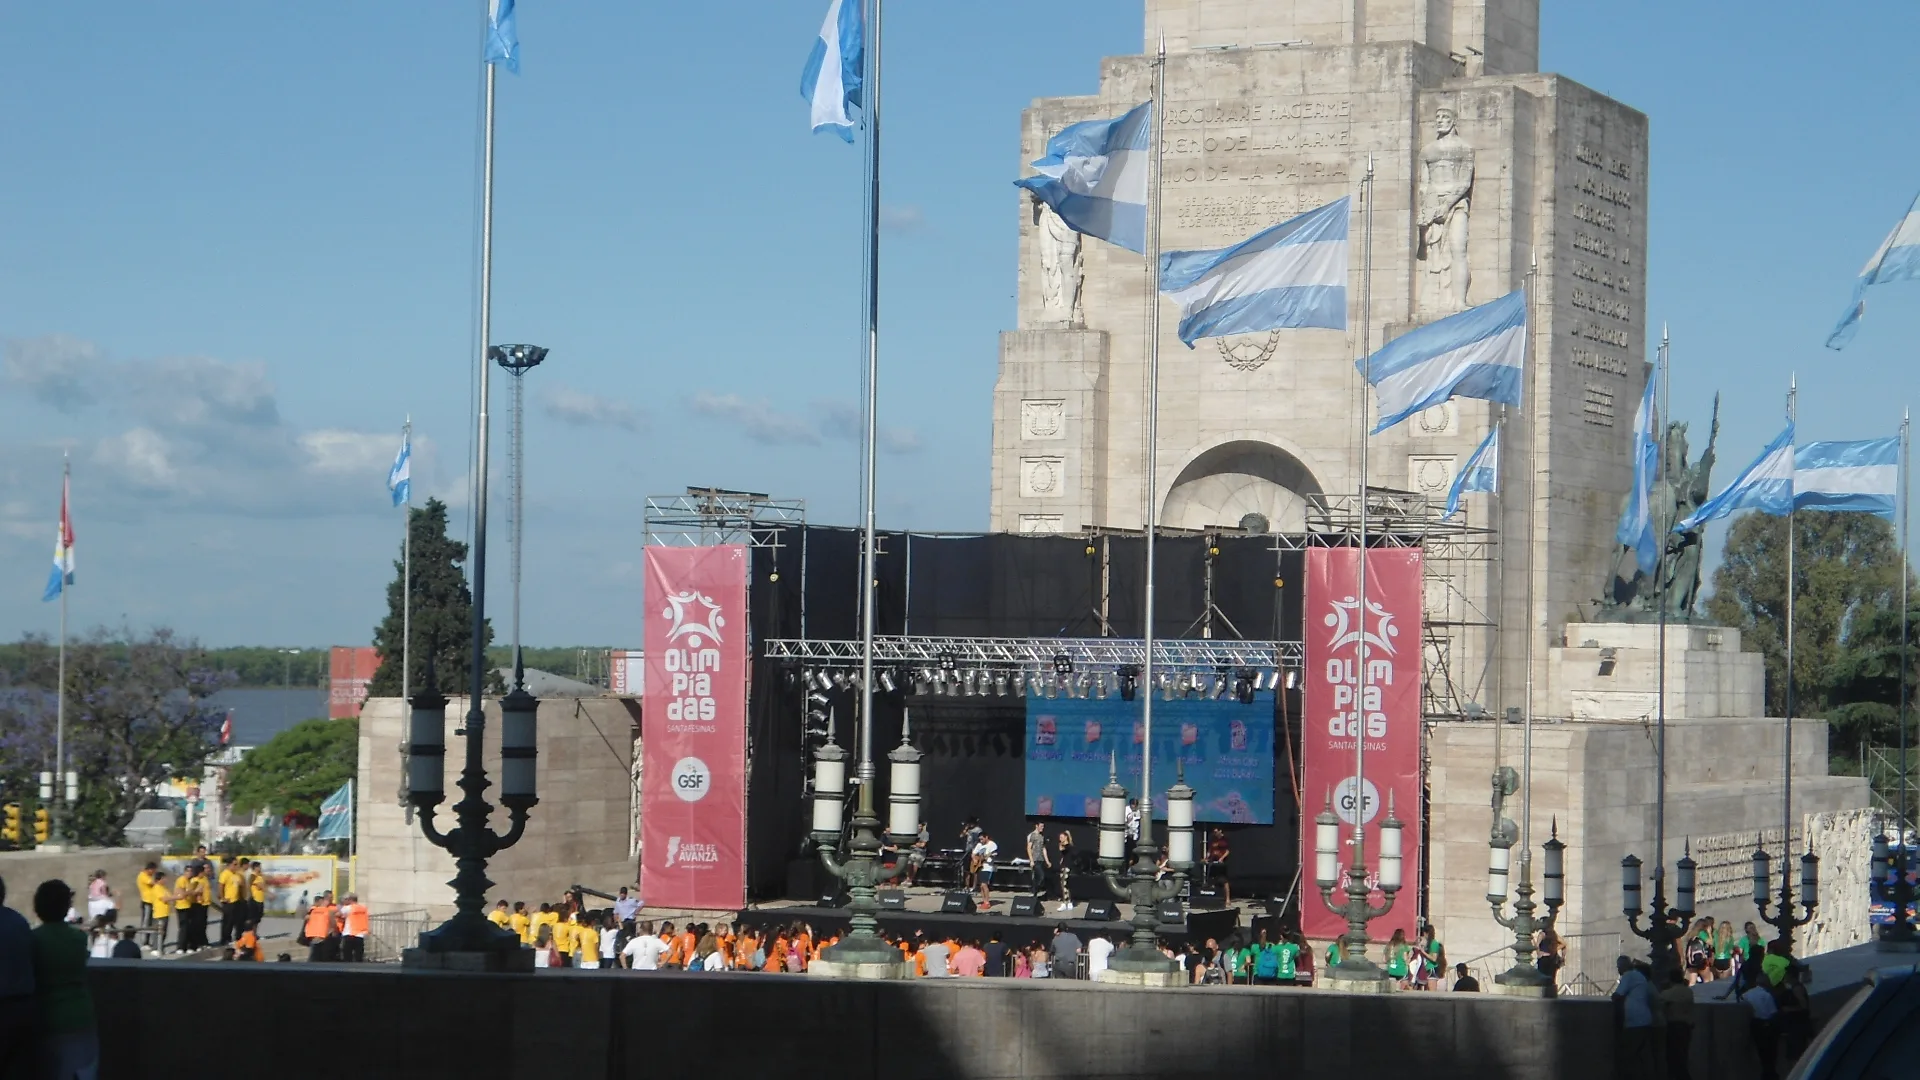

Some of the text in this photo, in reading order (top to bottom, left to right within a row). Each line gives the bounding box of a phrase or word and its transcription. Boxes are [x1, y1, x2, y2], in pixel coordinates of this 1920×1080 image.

[1269, 102, 1349, 120] HACERME
[1223, 135, 1248, 152] DE
[1251, 130, 1349, 150] LLAMARME
[1205, 165, 1229, 182] DE
[1238, 165, 1264, 180] LA
[1274, 162, 1347, 180] PATRIA
[667, 725, 716, 733] SANTAFESINAS
[1328, 741, 1387, 751] SANTAFSINAS
[678, 774, 703, 788] GSF
[680, 843, 716, 853] SANTA FE
[679, 851, 719, 862] AVANZA
